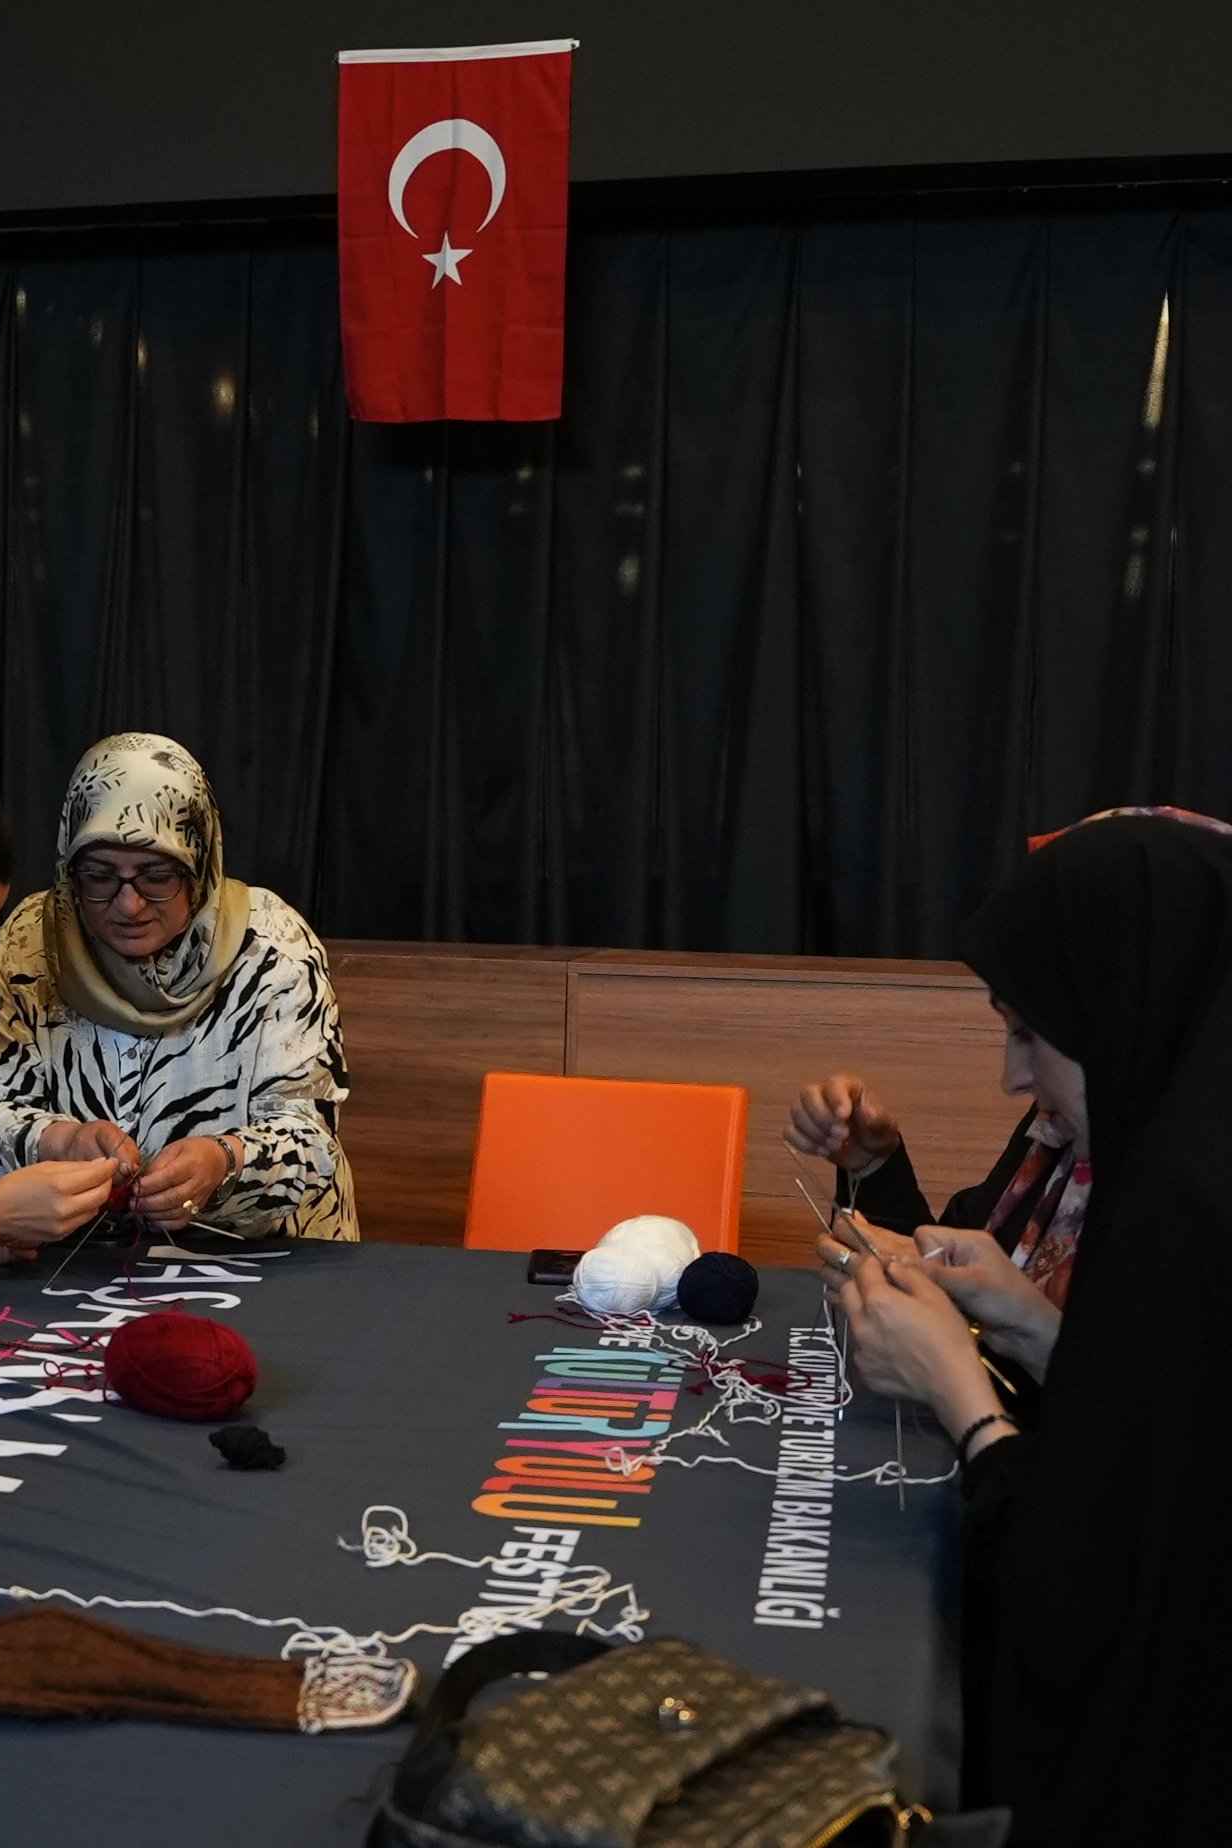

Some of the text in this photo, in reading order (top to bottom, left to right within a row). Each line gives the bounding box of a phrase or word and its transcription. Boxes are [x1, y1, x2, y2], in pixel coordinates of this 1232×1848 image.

[496, 1346, 685, 1438] KÜLTÜR
[470, 1438, 657, 1529] YOLU
[753, 1499, 842, 1630] BAKANLIĞI
